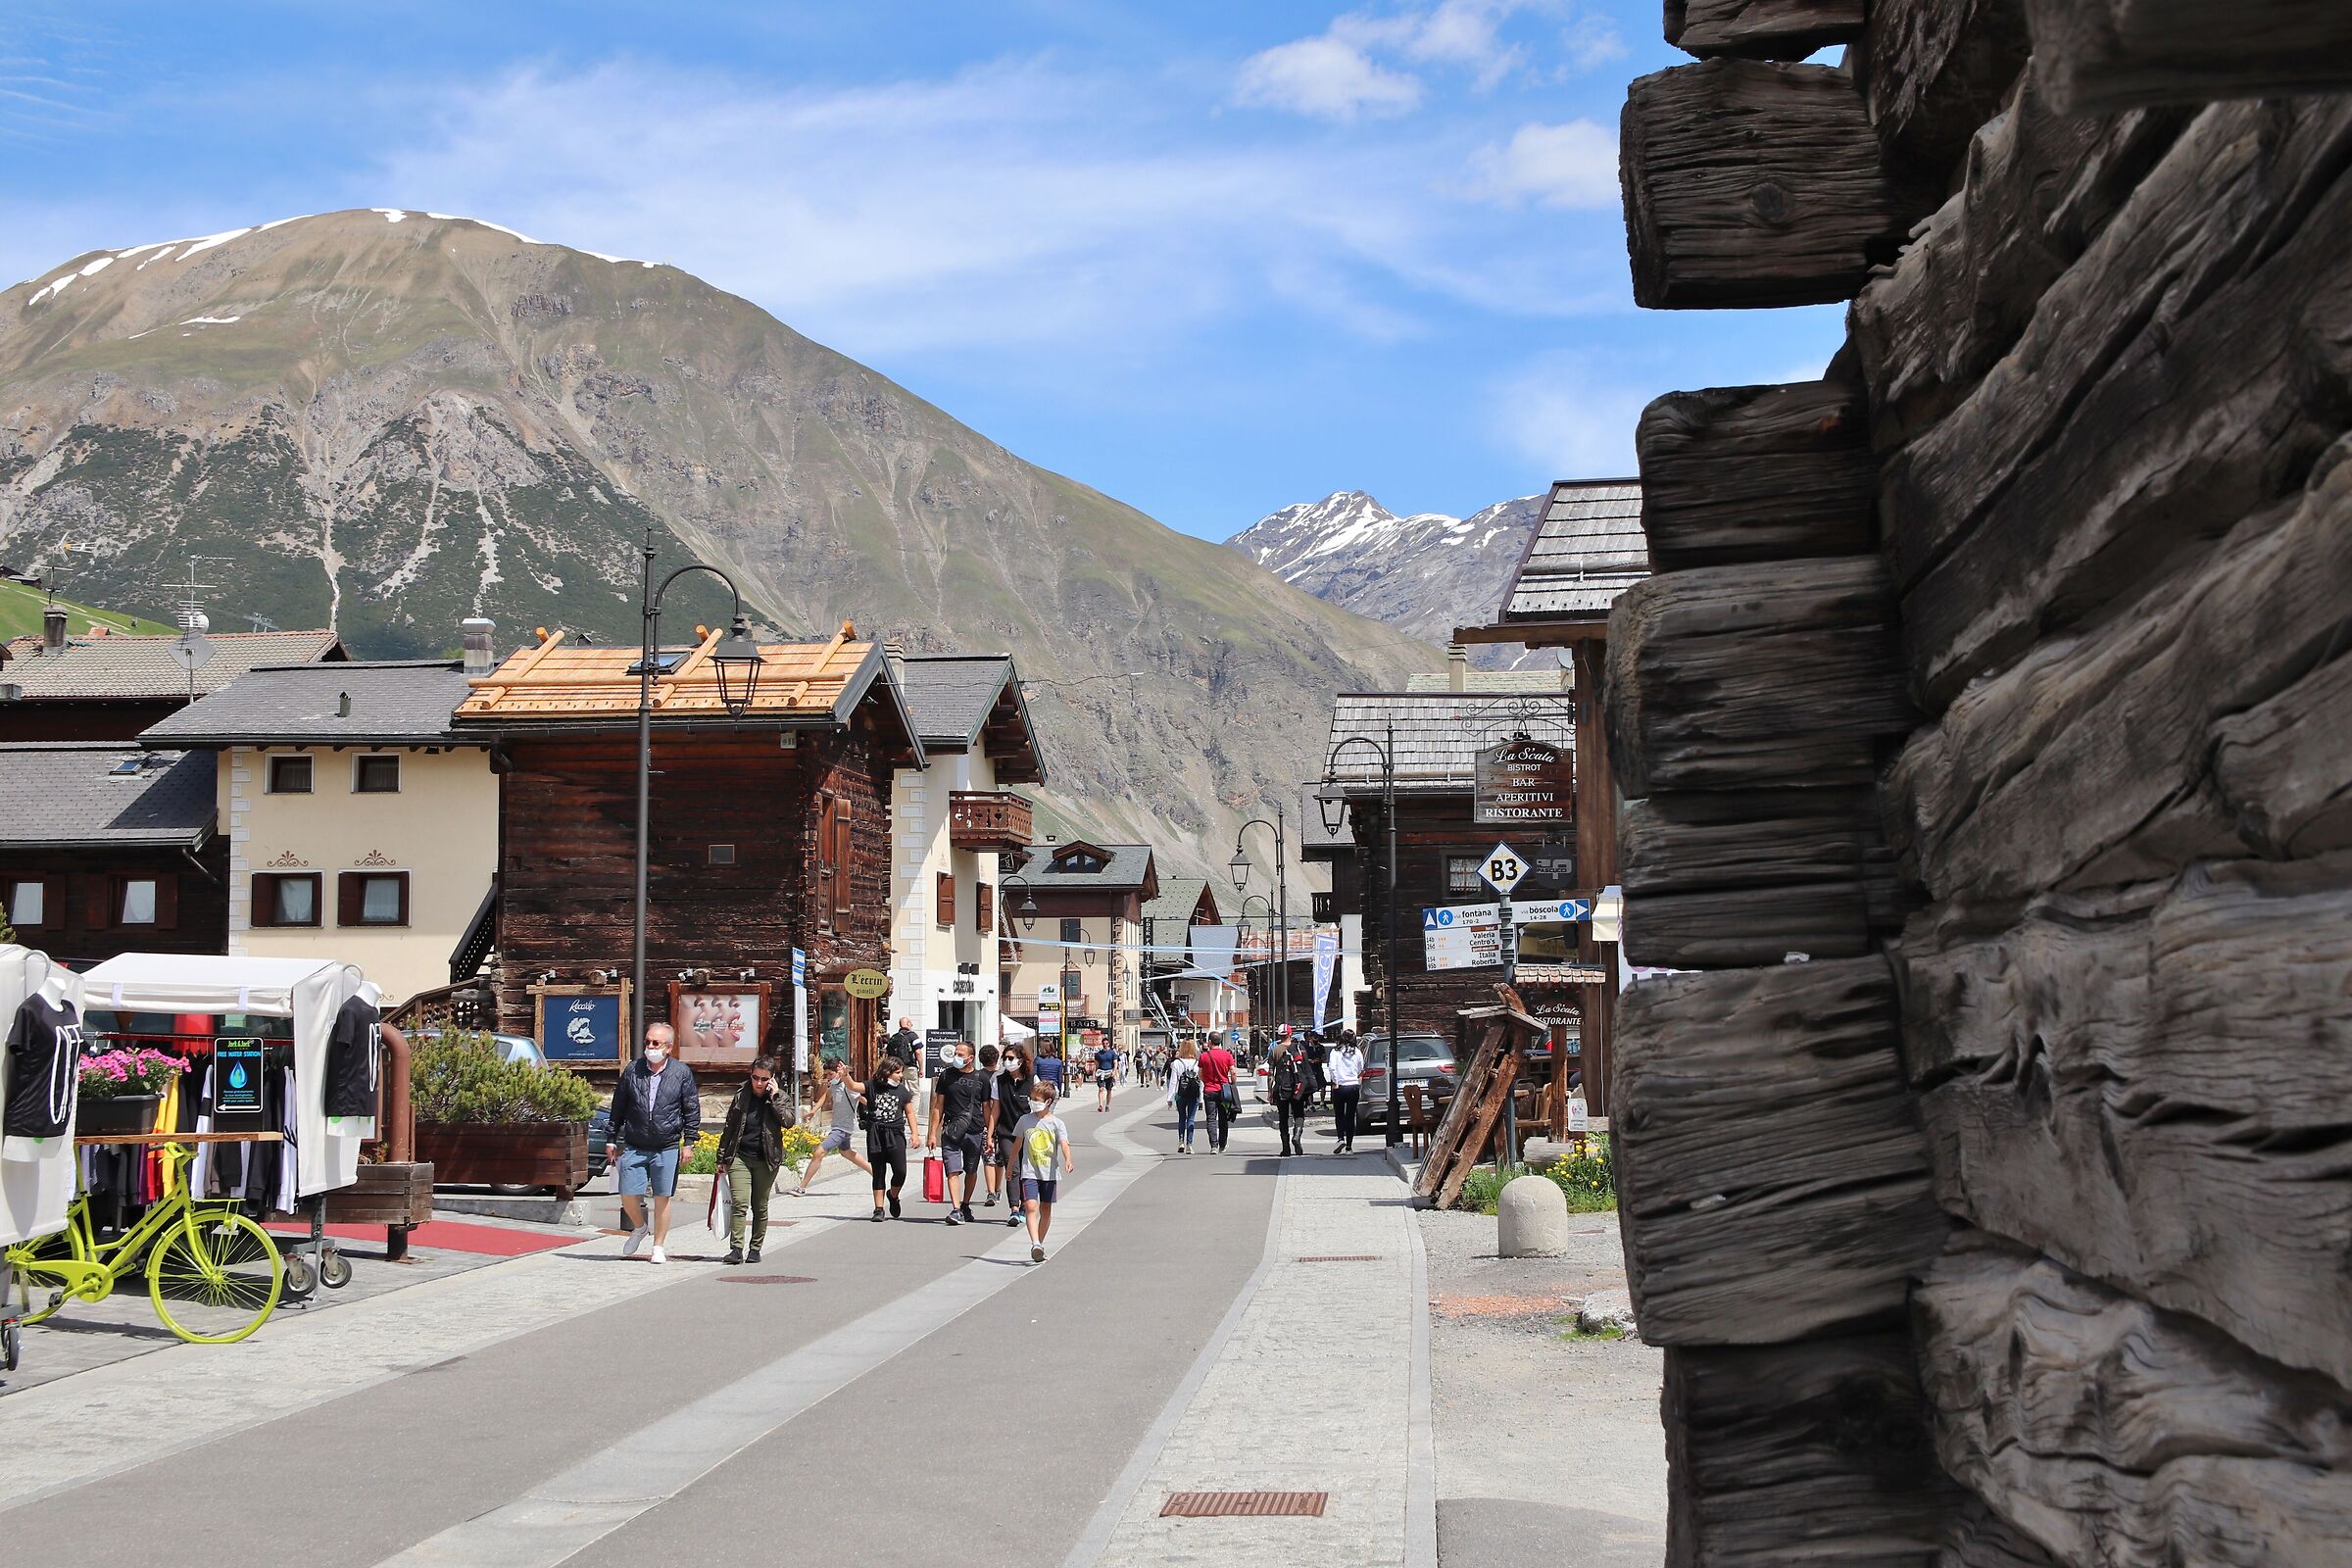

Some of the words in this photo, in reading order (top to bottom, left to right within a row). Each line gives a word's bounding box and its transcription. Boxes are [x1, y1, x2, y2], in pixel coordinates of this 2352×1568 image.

[1494, 748, 1516, 763] La
[1512, 777, 1536, 787] BAR
[1495, 792, 1554, 802] APERITIVI
[1485, 808, 1563, 817] RISTORANTE
[1491, 858, 1518, 882] B3
[1462, 908, 1493, 918] fontàna
[1529, 906, 1559, 914] bòscola
[1536, 1004, 1551, 1015] La
